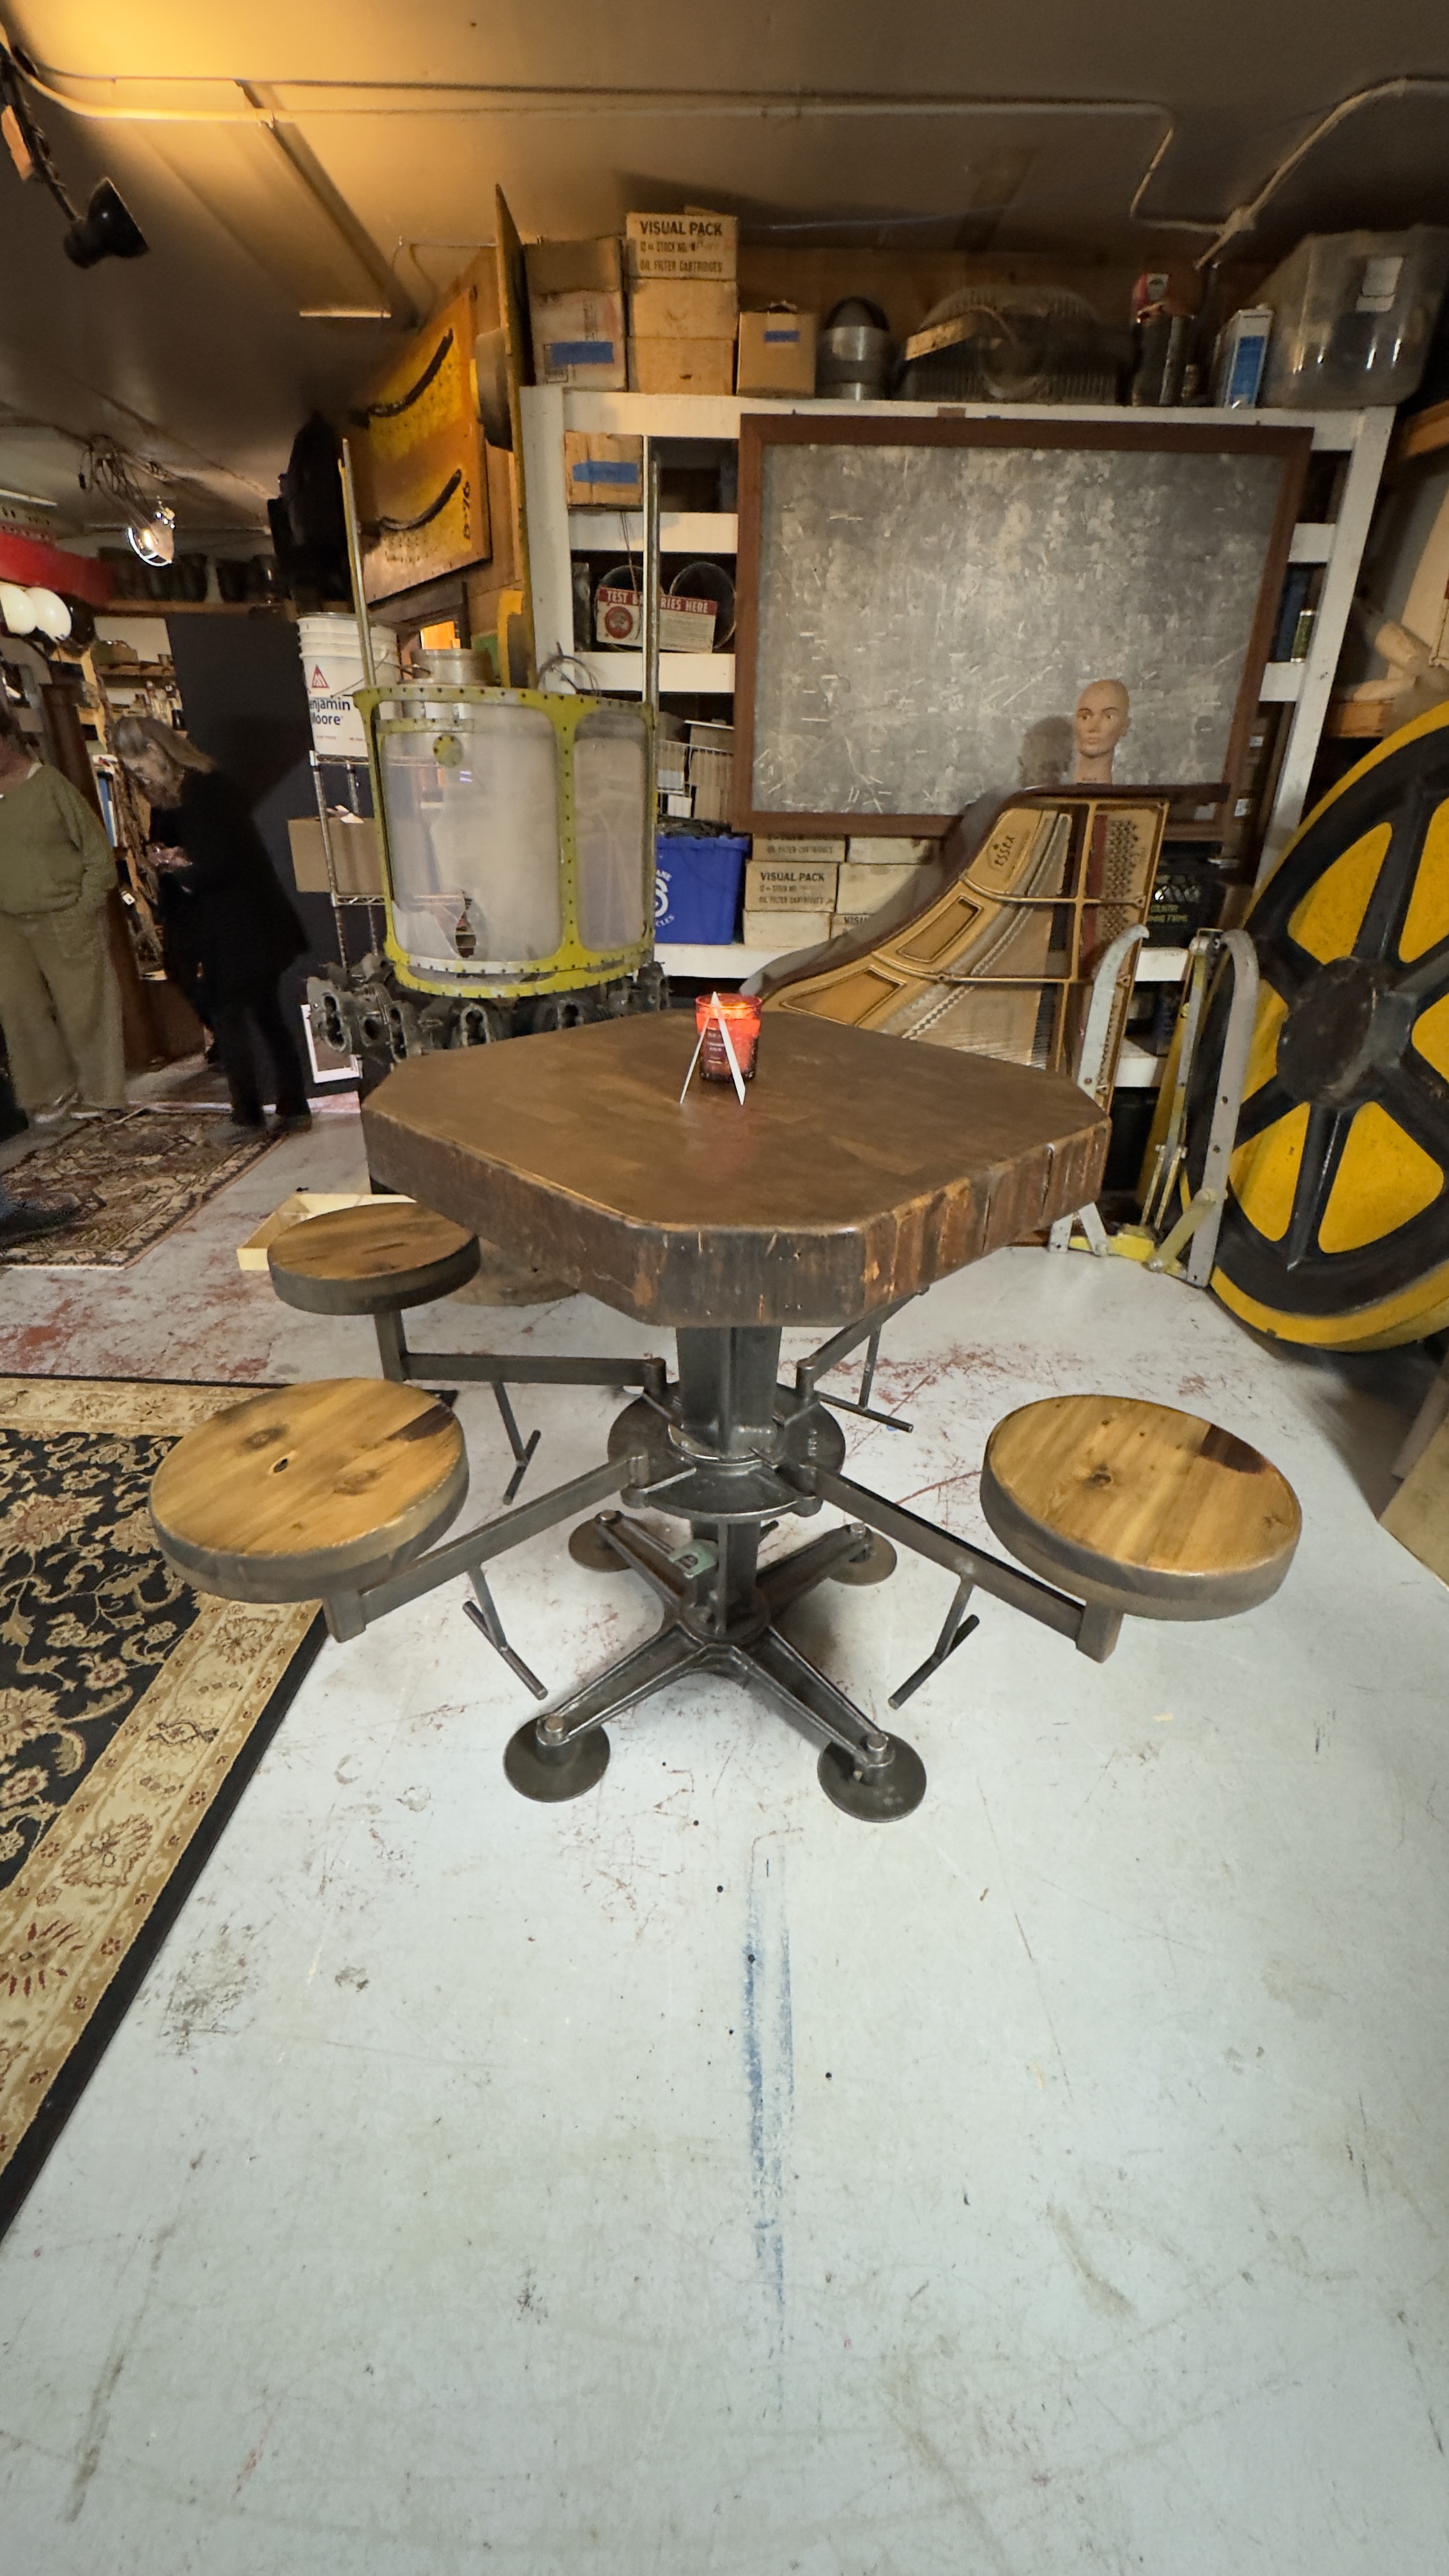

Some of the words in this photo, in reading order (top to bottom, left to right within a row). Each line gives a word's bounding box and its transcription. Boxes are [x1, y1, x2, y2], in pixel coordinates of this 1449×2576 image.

[640, 220, 686, 235] VISUAL
[689, 222, 723, 236] PACK
[654, 260, 676, 272] FILTER
[679, 260, 723, 273] CARTRIDGES
[607, 590, 628, 603] TEST
[685, 599, 708, 613] HERE
[309, 696, 351, 712] enjamin
[760, 871, 796, 881] VISUAL
[799, 873, 825, 882] PACK
